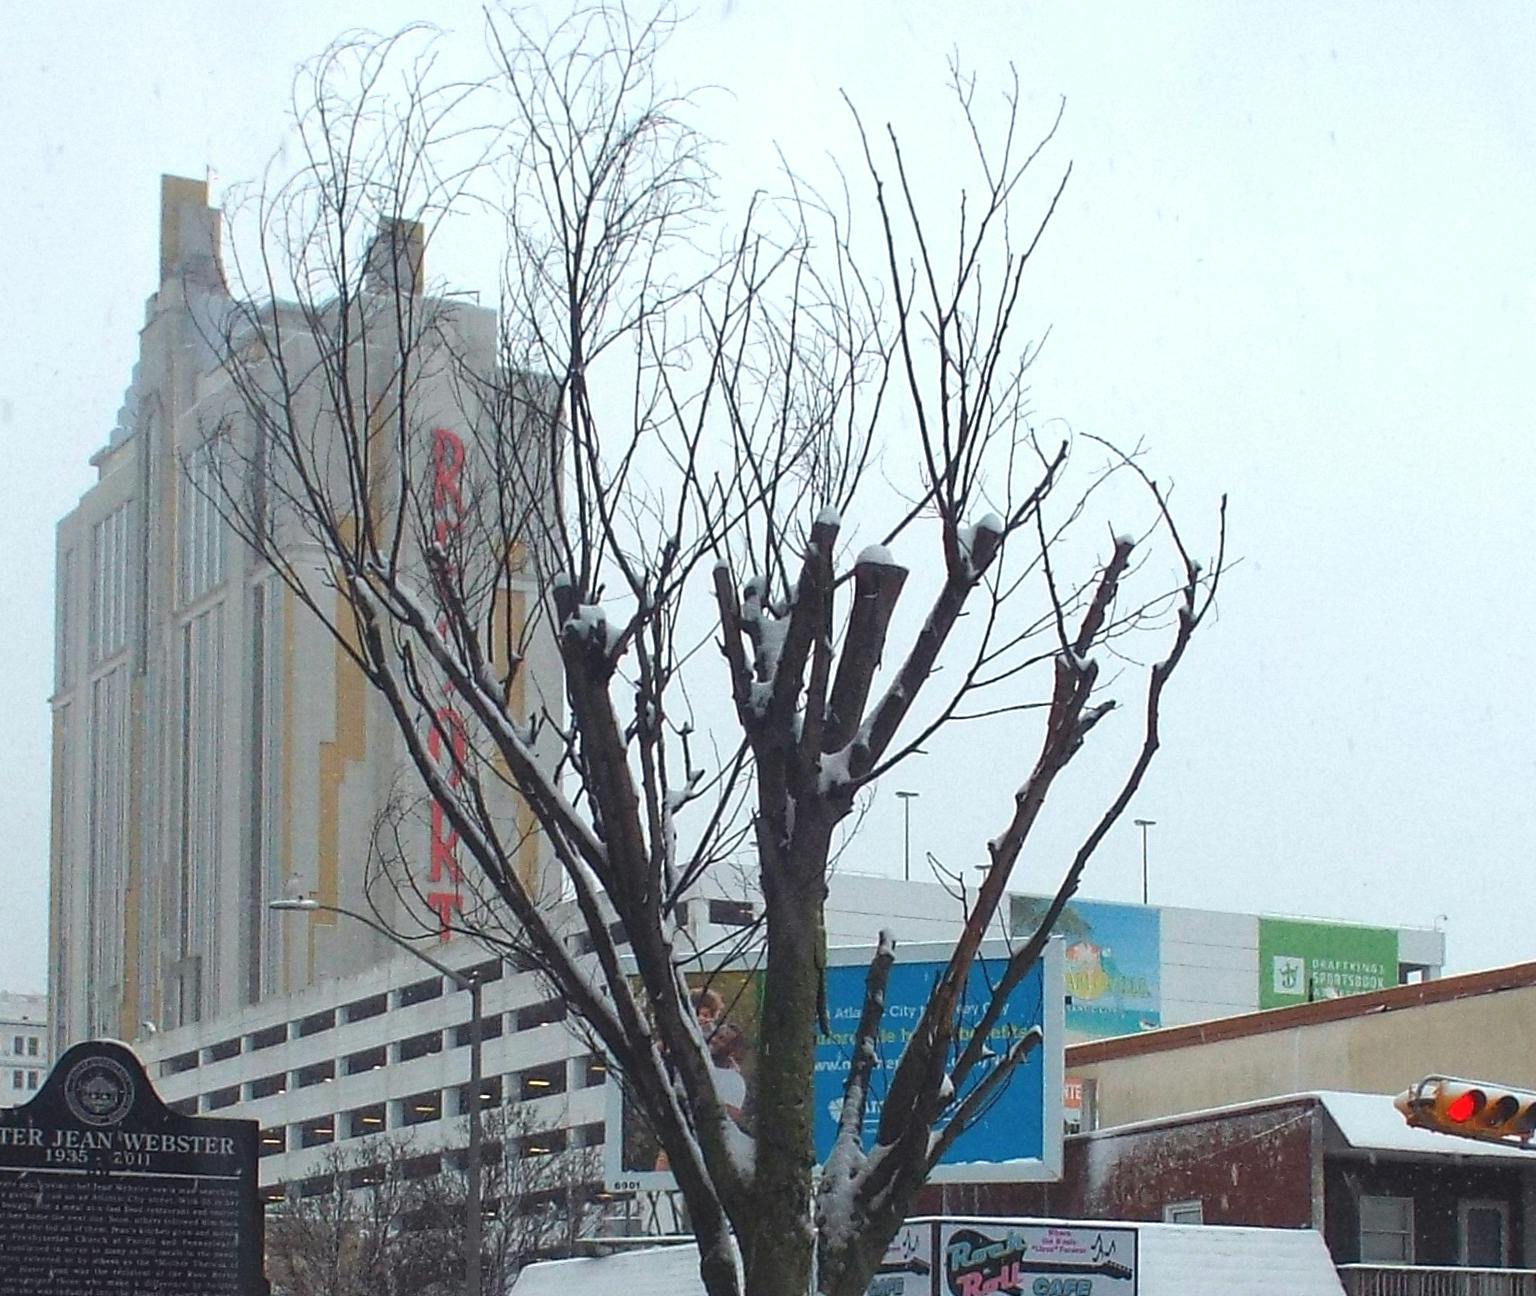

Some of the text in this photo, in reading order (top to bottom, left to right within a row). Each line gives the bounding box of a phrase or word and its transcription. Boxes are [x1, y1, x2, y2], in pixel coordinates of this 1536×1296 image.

[1311, 971, 1384, 988] SPORTSBOOK
[51, 1129, 113, 1150] JEAN
[123, 1133, 236, 1156] WEBSTER
[45, 1148, 89, 1164] 1935
[113, 1151, 152, 1166] 2011
[614, 1181, 641, 1190] 6901
[948, 1230, 1026, 1271] Rock
[1032, 1277, 1092, 1296] CAFE
